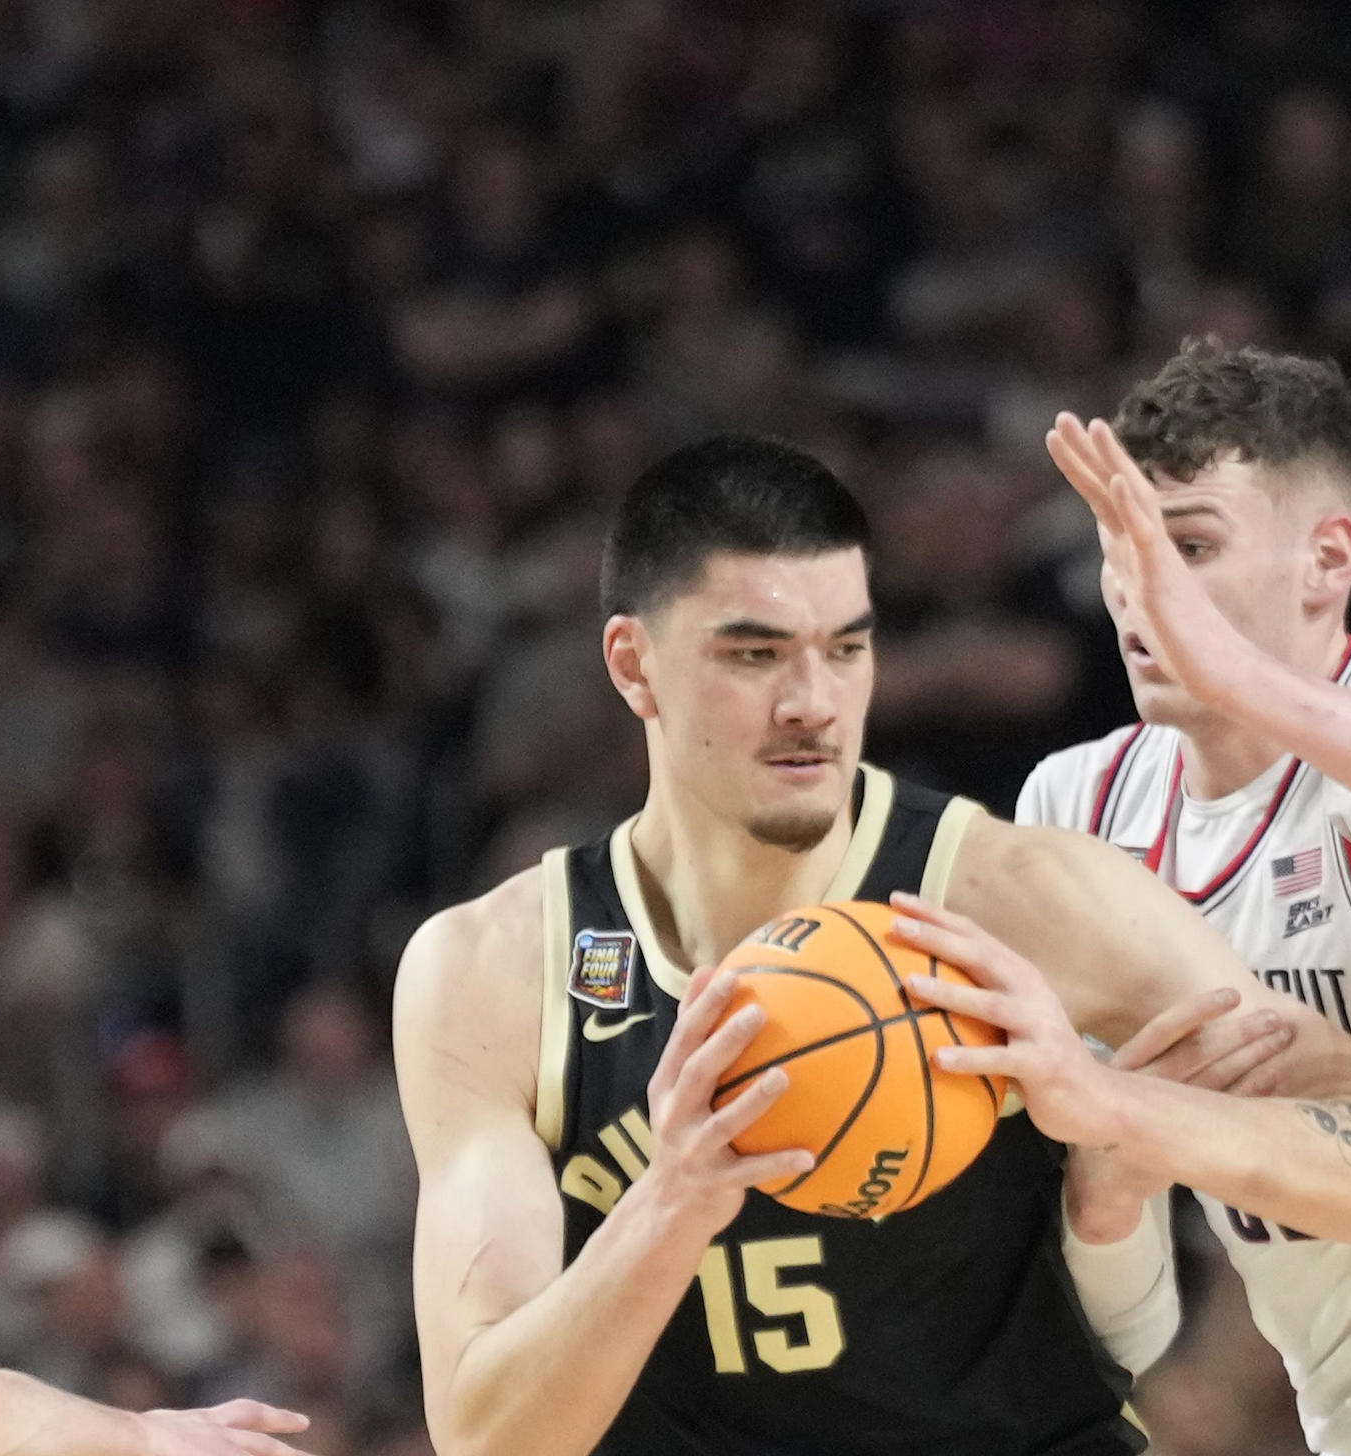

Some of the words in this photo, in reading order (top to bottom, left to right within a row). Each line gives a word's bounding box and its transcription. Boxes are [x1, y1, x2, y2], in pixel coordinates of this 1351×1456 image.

[1285, 904, 1334, 932] EAST
[583, 947, 621, 963] FINAL
[580, 962, 619, 980] FOUR
[696, 1236, 846, 1374] 15
